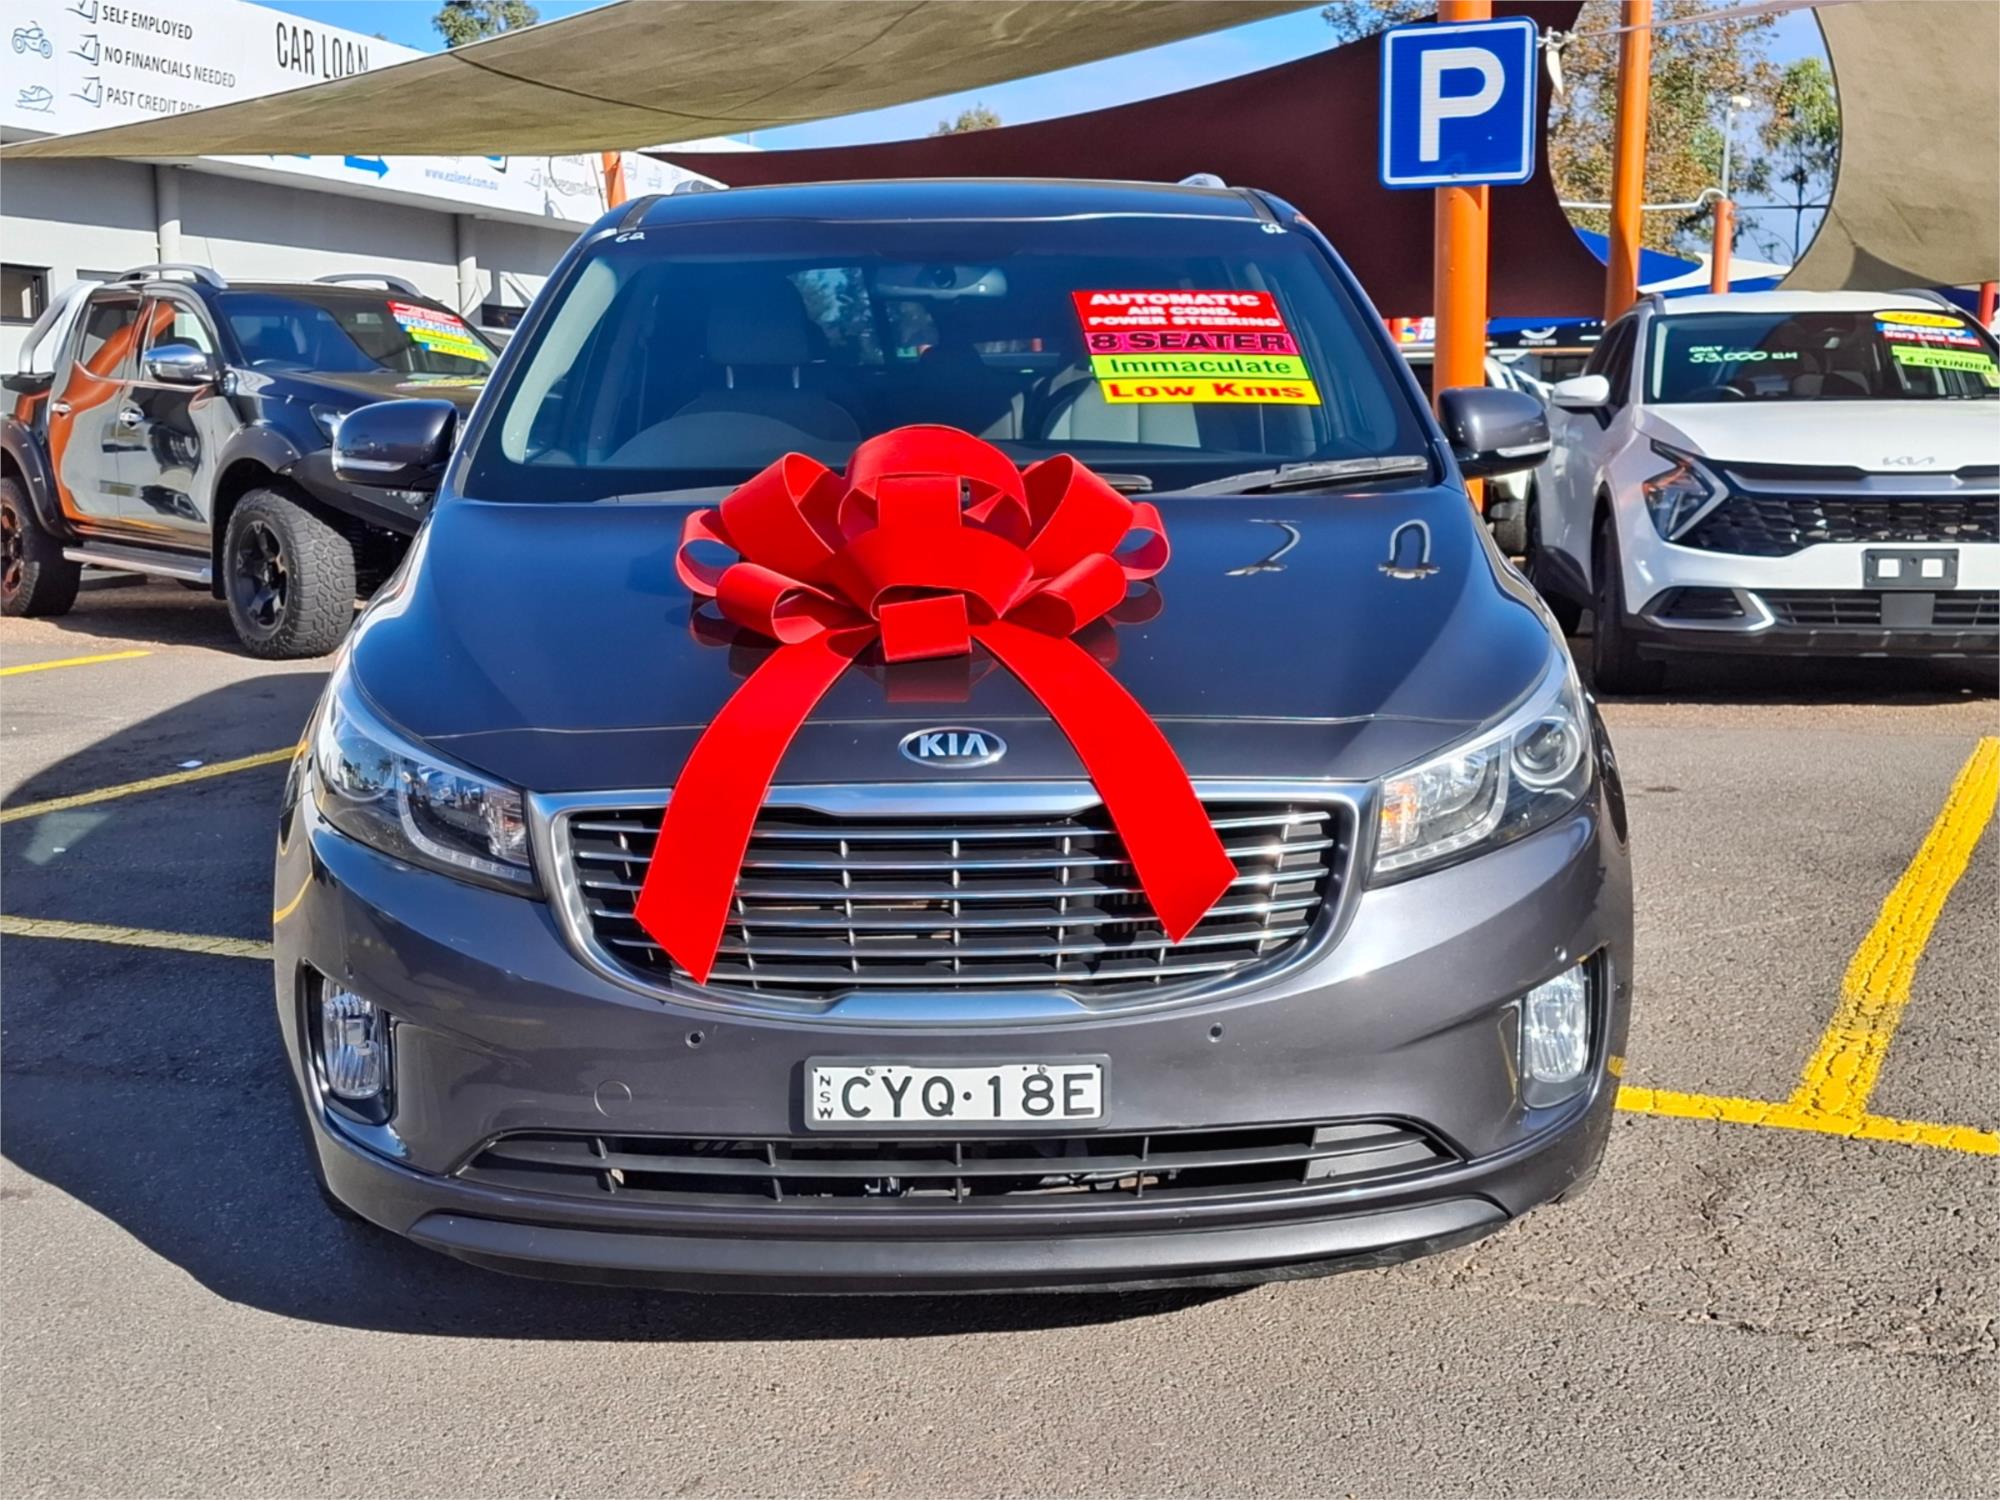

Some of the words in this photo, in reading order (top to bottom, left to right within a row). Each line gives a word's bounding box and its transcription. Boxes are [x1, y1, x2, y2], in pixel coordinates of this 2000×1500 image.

[103, 5, 128, 24] SELF
[131, 12, 193, 40] EMPLOYED
[277, 21, 315, 76] CAR
[322, 33, 369, 79] LOAN
[104, 46, 123, 64] NO
[125, 51, 191, 79] FINANCIALS
[194, 66, 236, 88] NEEDED
[106, 87, 135, 107] PAST
[137, 93, 178, 114] CREDIT
[1419, 47, 1506, 163] P
[1090, 293, 1261, 307] AUTOMATIC
[1088, 316, 1168, 326] POWER
[1171, 316, 1281, 327] STEERING
[1127, 306, 1167, 316] AIR
[1168, 306, 1238, 317] COND.
[1090, 333, 1119, 349] 8
[1128, 333, 1287, 350] SEATER
[1110, 358, 1292, 374] Immaculate
[1109, 383, 1195, 398] Low
[1211, 383, 1305, 398] Kms
[919, 733, 989, 757] KIA
